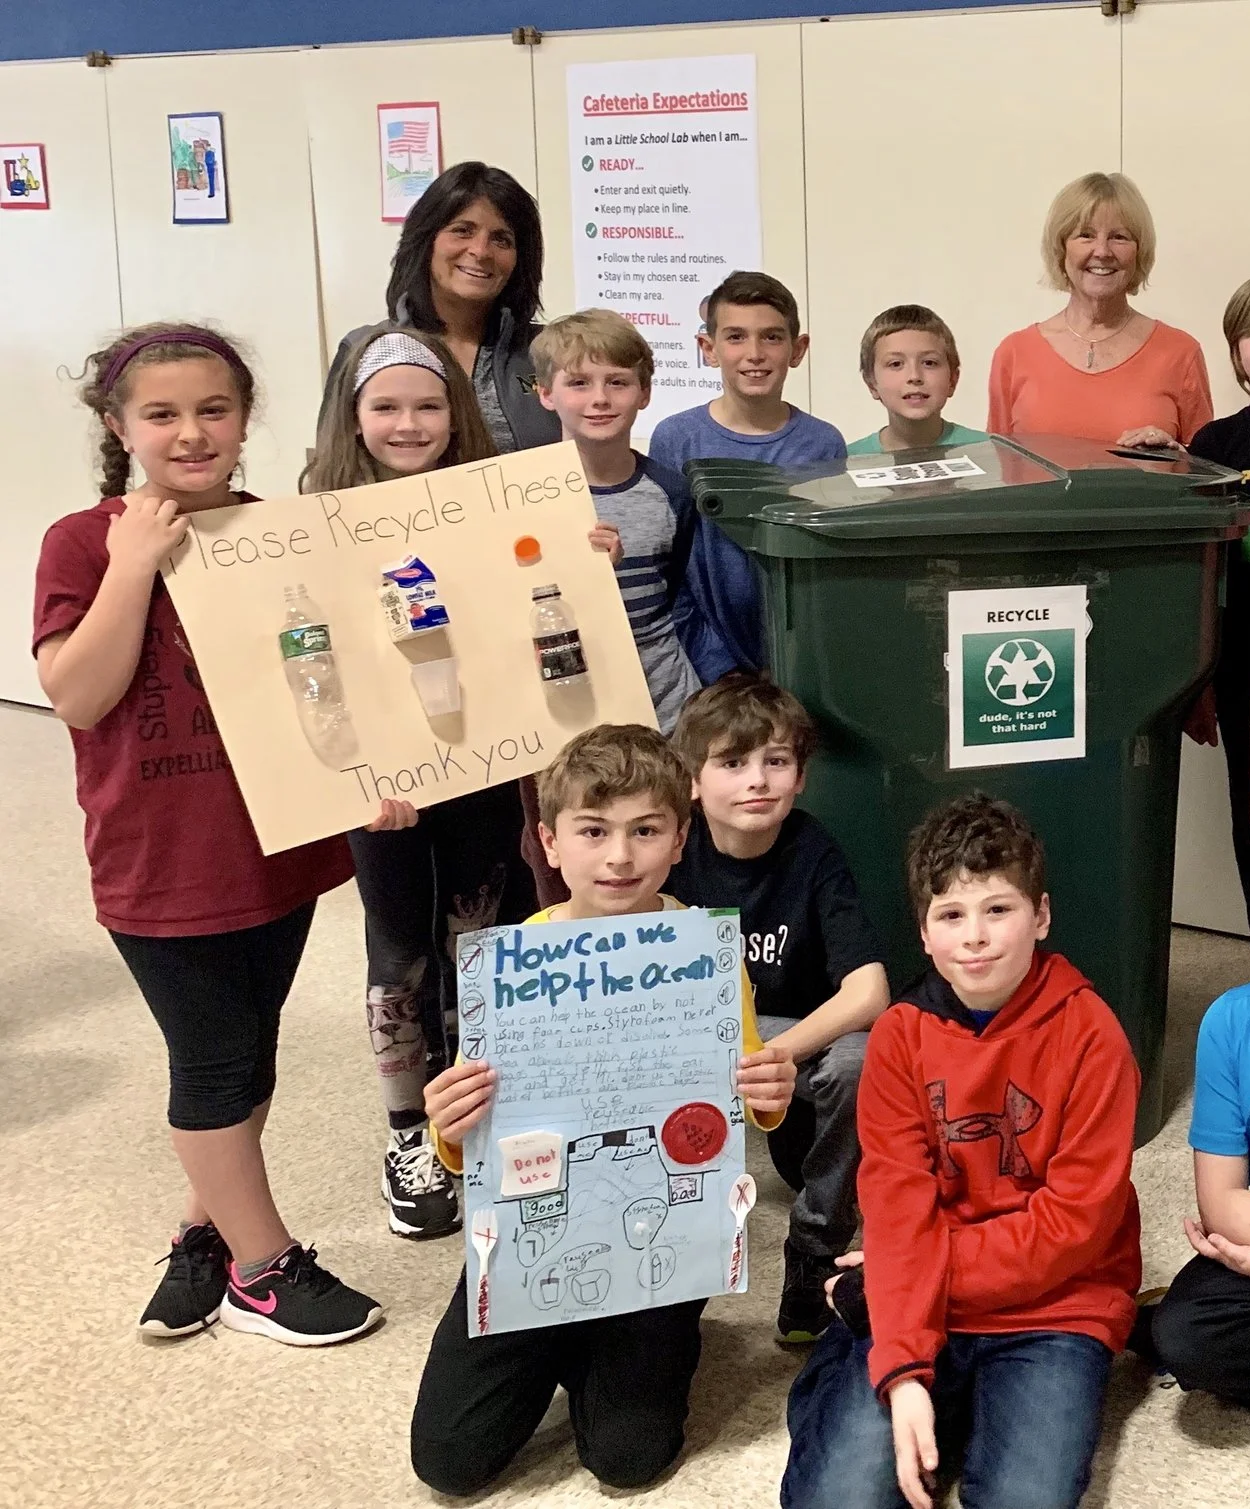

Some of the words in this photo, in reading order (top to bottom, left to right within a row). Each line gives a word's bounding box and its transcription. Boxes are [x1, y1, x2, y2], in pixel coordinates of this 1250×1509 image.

[583, 93, 649, 114] Cafeteria
[652, 89, 748, 112] Expectations
[590, 137, 605, 146] am
[615, 134, 638, 145] Little
[639, 132, 669, 144] School
[671, 132, 689, 143] Lab
[691, 131, 717, 143] when
[599, 158, 644, 171] READY...
[600, 185, 622, 195] Enter
[624, 185, 639, 195] and
[641, 184, 657, 195] exit
[659, 183, 692, 197] quietly.
[600, 203, 621, 215] Keep
[623, 206, 636, 215] my
[638, 203, 660, 215] place
[661, 203, 670, 213] in
[672, 203, 691, 213] line.
[602, 226, 684, 239] RESPONSIBLE...
[603, 252, 630, 264] Follow
[631, 253, 645, 263] the
[647, 253, 668, 263] rules
[670, 253, 686, 263] and
[688, 253, 727, 264] routines.
[604, 271, 622, 283] Stay
[623, 271, 630, 281] in
[632, 273, 645, 283] my
[647, 271, 677, 282] chosen
[679, 273, 700, 282] seat.
[604, 289, 628, 300] Clean
[629, 291, 642, 301] my
[643, 291, 665, 300] area.
[665, 360, 690, 369] voice.
[660, 377, 687, 388] adults
[688, 377, 697, 387] in
[698, 377, 722, 391] charg
[315, 478, 466, 547] Recycle
[466, 462, 585, 515] These
[987, 608, 1050, 623] RECYCLE
[979, 710, 1012, 724] dude,
[1015, 710, 1034, 720] it's
[1037, 709, 1057, 719] not
[991, 722, 1017, 734] that
[1019, 721, 1047, 731] hard
[340, 742, 467, 803] Thank
[473, 730, 544, 784] you
[495, 929, 573, 975] How
[636, 921, 677, 946] we
[493, 968, 573, 1010] help
[573, 960, 634, 1003] the
[495, 1011, 515, 1028] You
[518, 1014, 546, 1026] can
[576, 1007, 597, 1019] the
[603, 1002, 646, 1017] ocean
[652, 998, 665, 1012] by
[675, 992, 696, 1009] not
[536, 1148, 556, 1165] not
